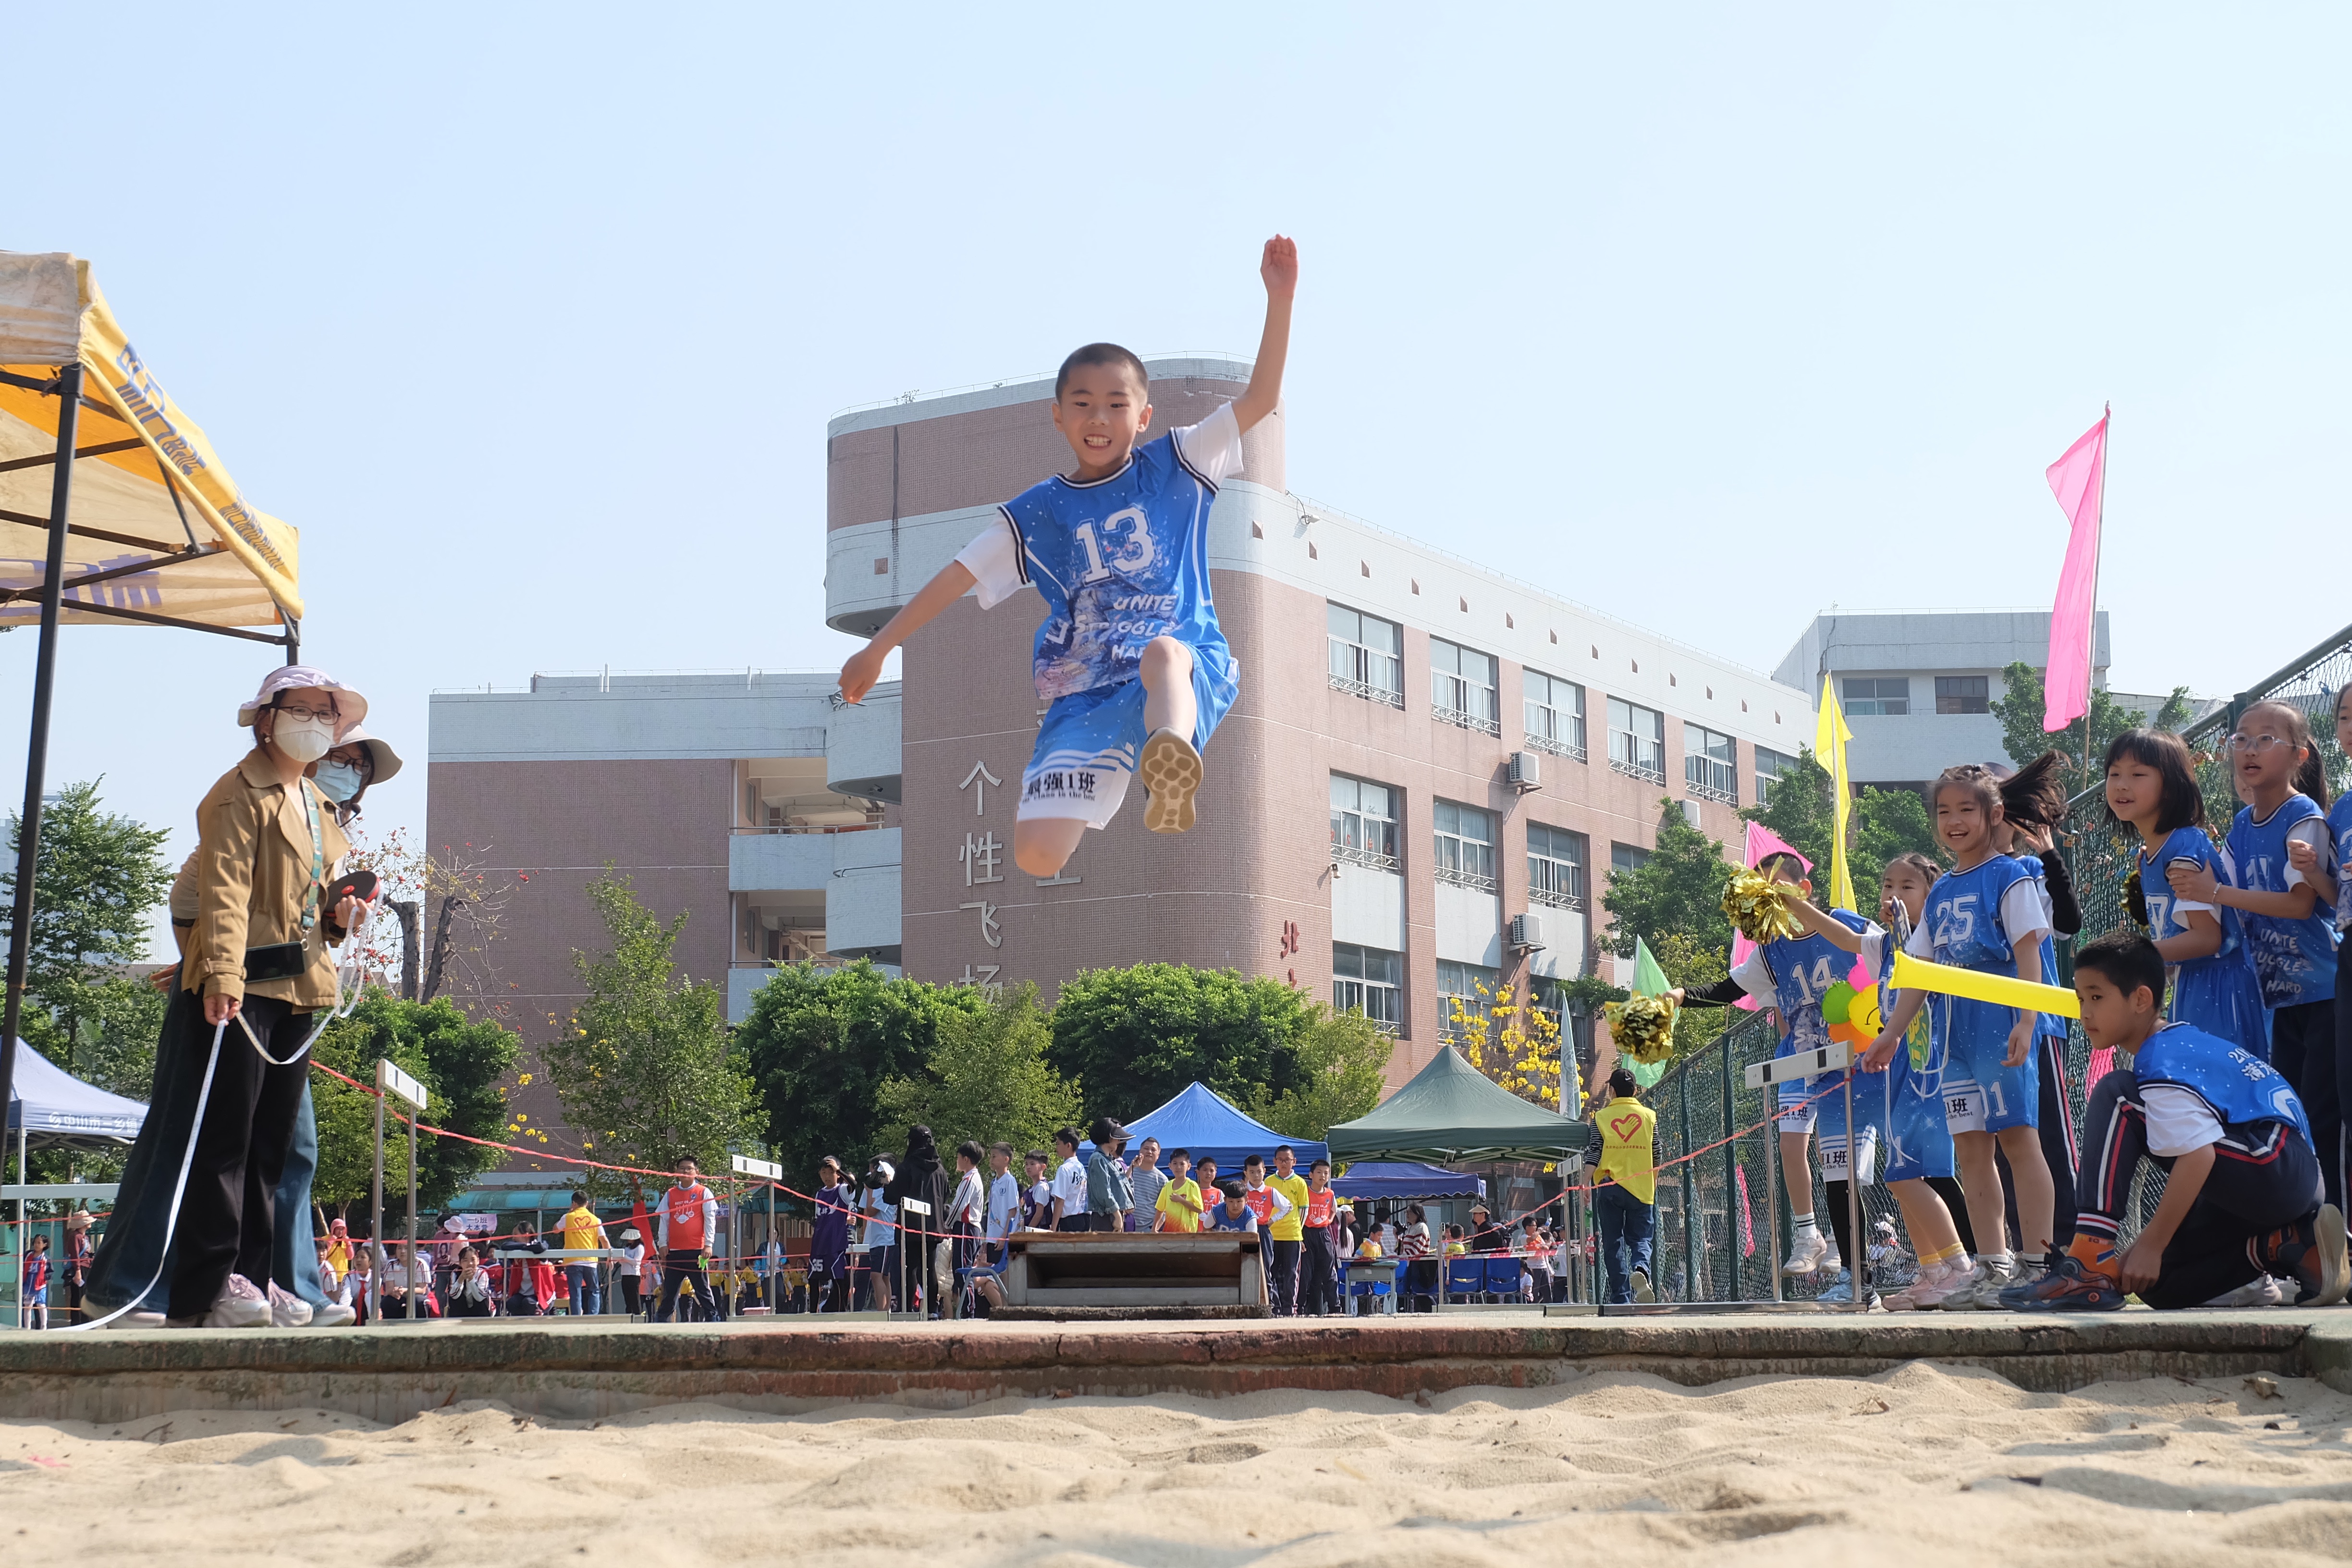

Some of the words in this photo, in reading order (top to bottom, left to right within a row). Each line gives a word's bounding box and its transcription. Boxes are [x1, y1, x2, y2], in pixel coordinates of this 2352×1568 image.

[1075, 504, 1156, 585] 13
[1114, 595, 1177, 610] UNITE
[1934, 893, 1979, 950] 25
[2261, 928, 2297, 949] UNITE
[1790, 956, 1838, 1007] 14
[2266, 980, 2302, 994] HARD
[811, 1259, 823, 1272] 35
